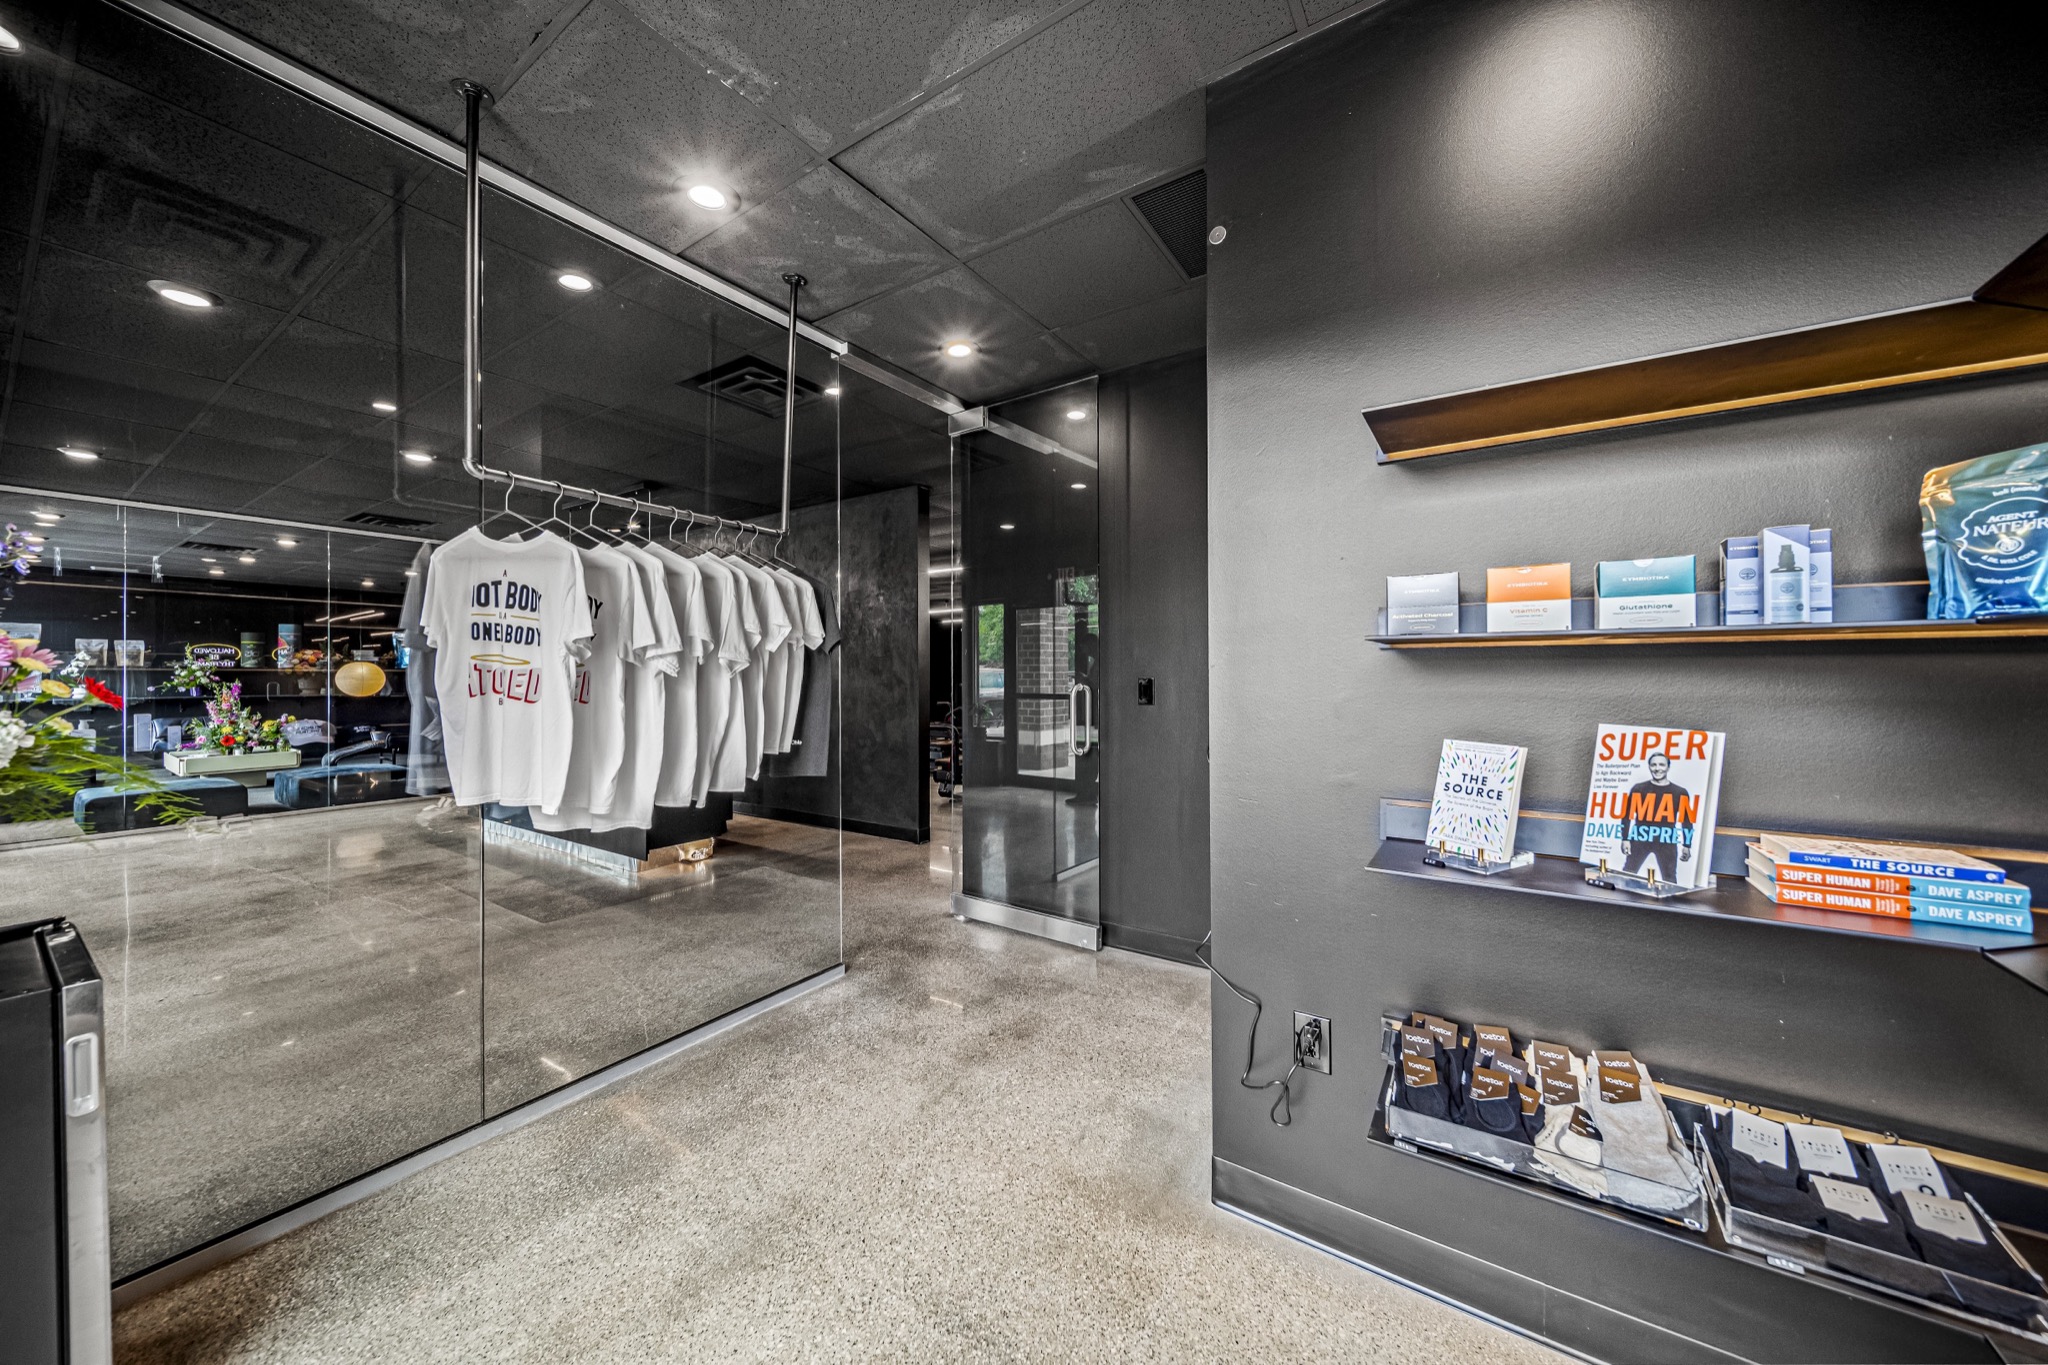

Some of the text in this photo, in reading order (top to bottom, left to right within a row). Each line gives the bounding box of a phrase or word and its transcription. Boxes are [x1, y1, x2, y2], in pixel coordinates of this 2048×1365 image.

[1973, 516, 2048, 537] NATEUR
[1986, 510, 2039, 523] AGENT
[503, 569, 508, 577] A
[1392, 612, 1422, 620] Activated
[1619, 603, 1673, 611] Glutathione
[1598, 729, 1709, 761] SUPER
[1461, 773, 1488, 786] THE
[1443, 782, 1504, 801] SOURCE
[1589, 791, 1700, 824] HUMAN
[1586, 822, 1695, 845] DAVE ASPREY
[1803, 855, 1955, 877] SWART THE SOURCE
[1782, 869, 1823, 883] SUPER
[1825, 874, 1871, 889] HUMAN
[1927, 884, 1963, 899] DAVE
[1966, 889, 2023, 905] ASPREY
[1782, 889, 1823, 904] SUPER
[1825, 894, 1872, 909] HUMAN
[1928, 905, 1963, 920] DAVE
[1967, 910, 2024, 928] ASPREY
